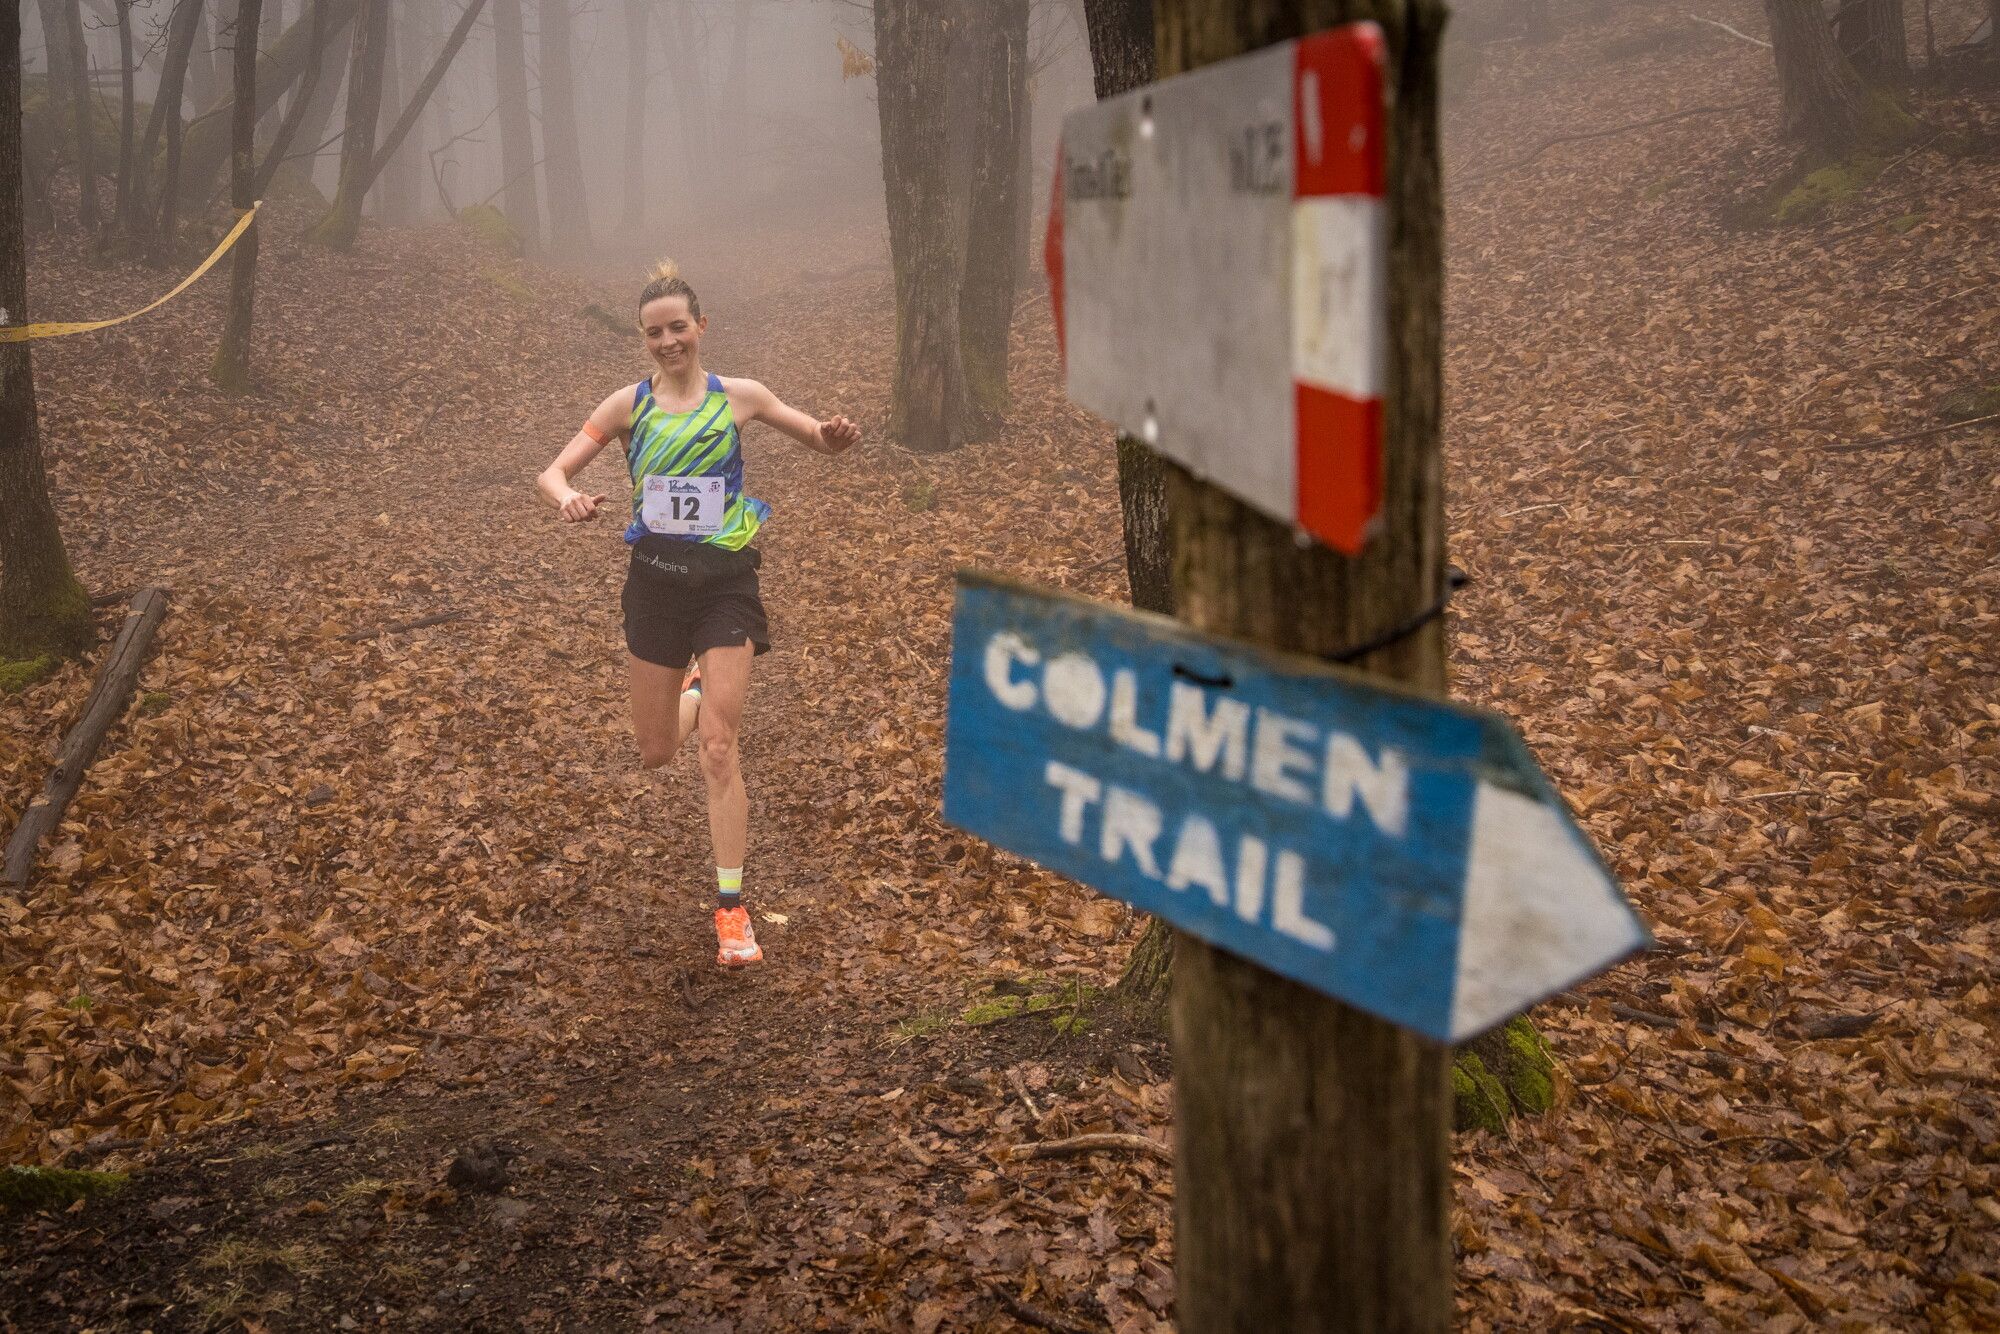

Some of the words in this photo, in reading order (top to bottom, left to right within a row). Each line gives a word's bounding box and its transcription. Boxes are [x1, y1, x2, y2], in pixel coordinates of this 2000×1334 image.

[670, 496, 700, 521] 12
[983, 630, 1409, 838] COLMEN
[1044, 760, 1336, 952] TRAIL
